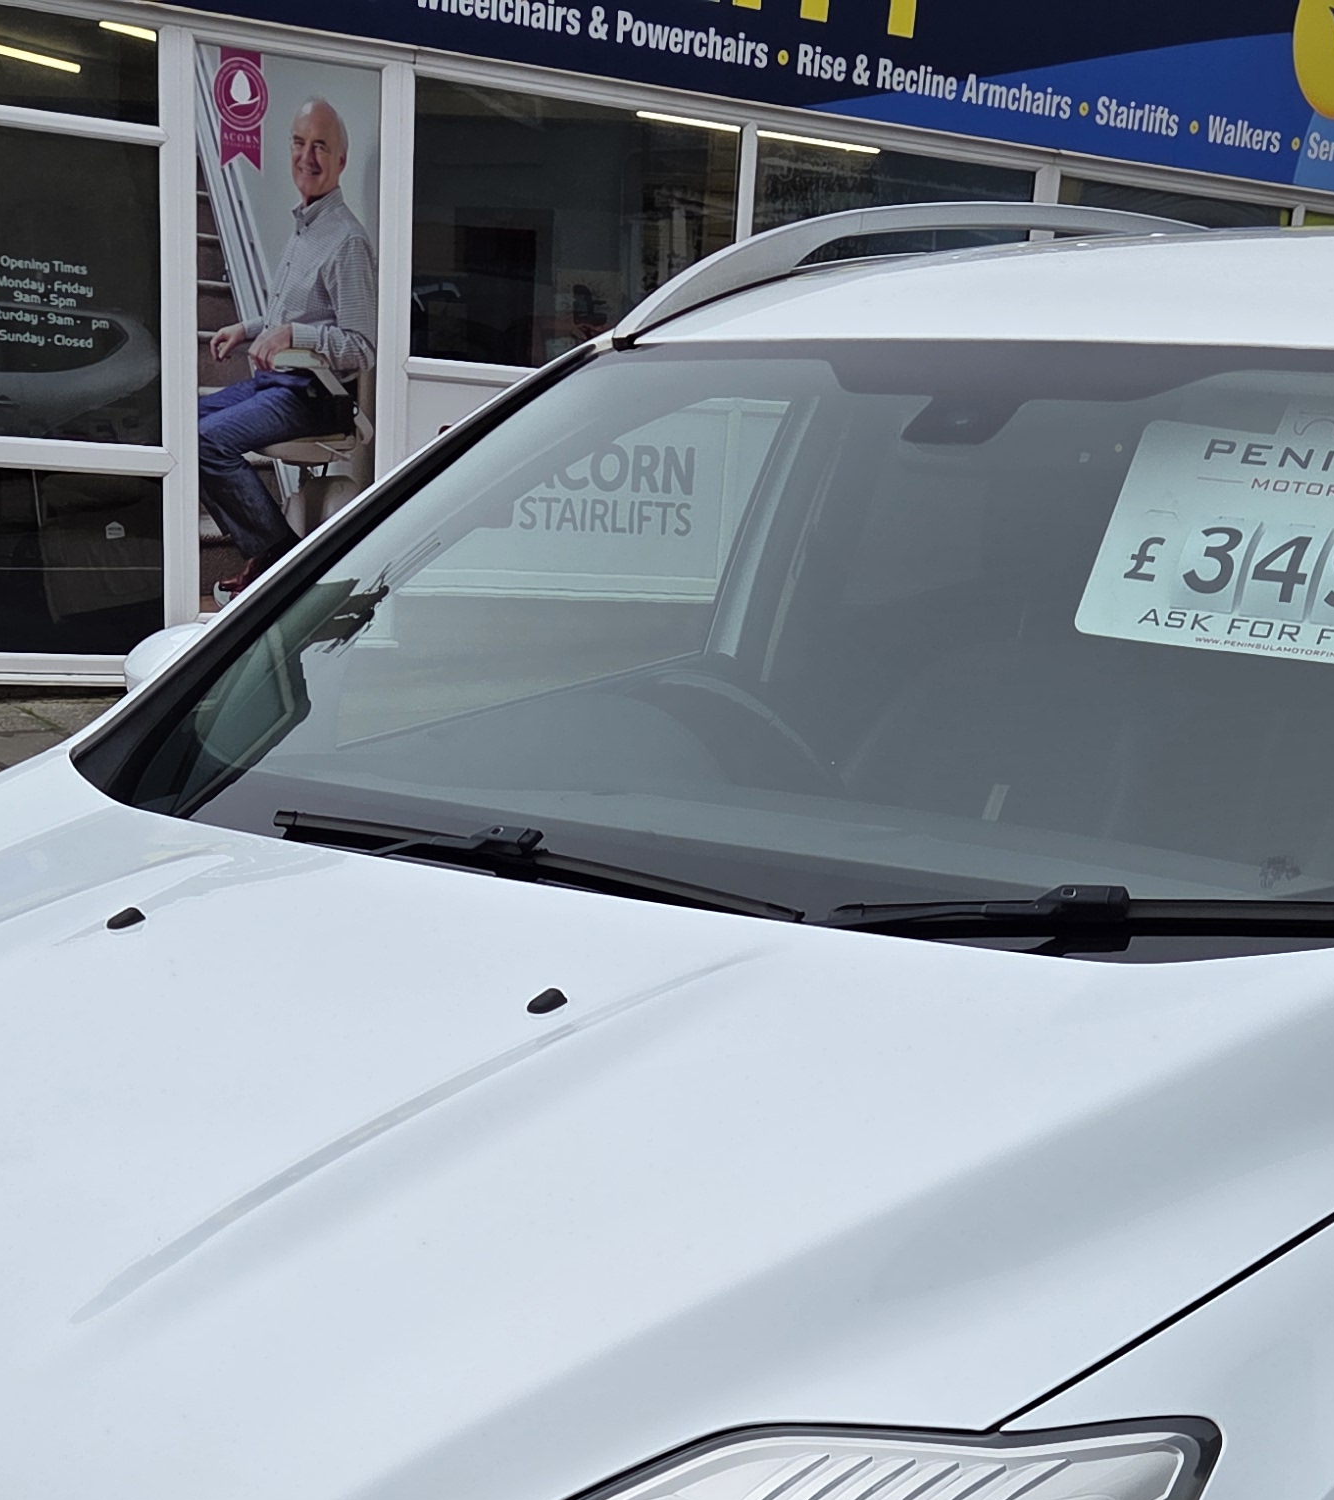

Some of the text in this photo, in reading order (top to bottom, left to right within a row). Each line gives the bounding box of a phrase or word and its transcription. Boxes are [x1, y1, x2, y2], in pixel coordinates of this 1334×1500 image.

[588, 5, 608, 41] &
[616, 9, 769, 69] Powerchairs
[797, 43, 847, 83] Rise
[852, 54, 871, 86] &
[876, 57, 958, 101] Recline
[961, 73, 1072, 120] Armchairs
[1095, 96, 1179, 138] Stairlifts
[1207, 114, 1282, 154] Walkers
[223, 131, 260, 144] ACORN
[0, 255, 88, 275] Opening Times
[53, 280, 93, 298] Friday
[13, 290, 41, 304] 9am
[49, 294, 77, 309] 5pm
[47, 313, 75, 326] 9am
[91, 319, 110, 330] pm
[53, 334, 93, 349] Closed
[518, 496, 692, 537] STAIRLIFTS
[1138, 608, 1215, 633] ASK
[1227, 618, 1301, 643] FOR
